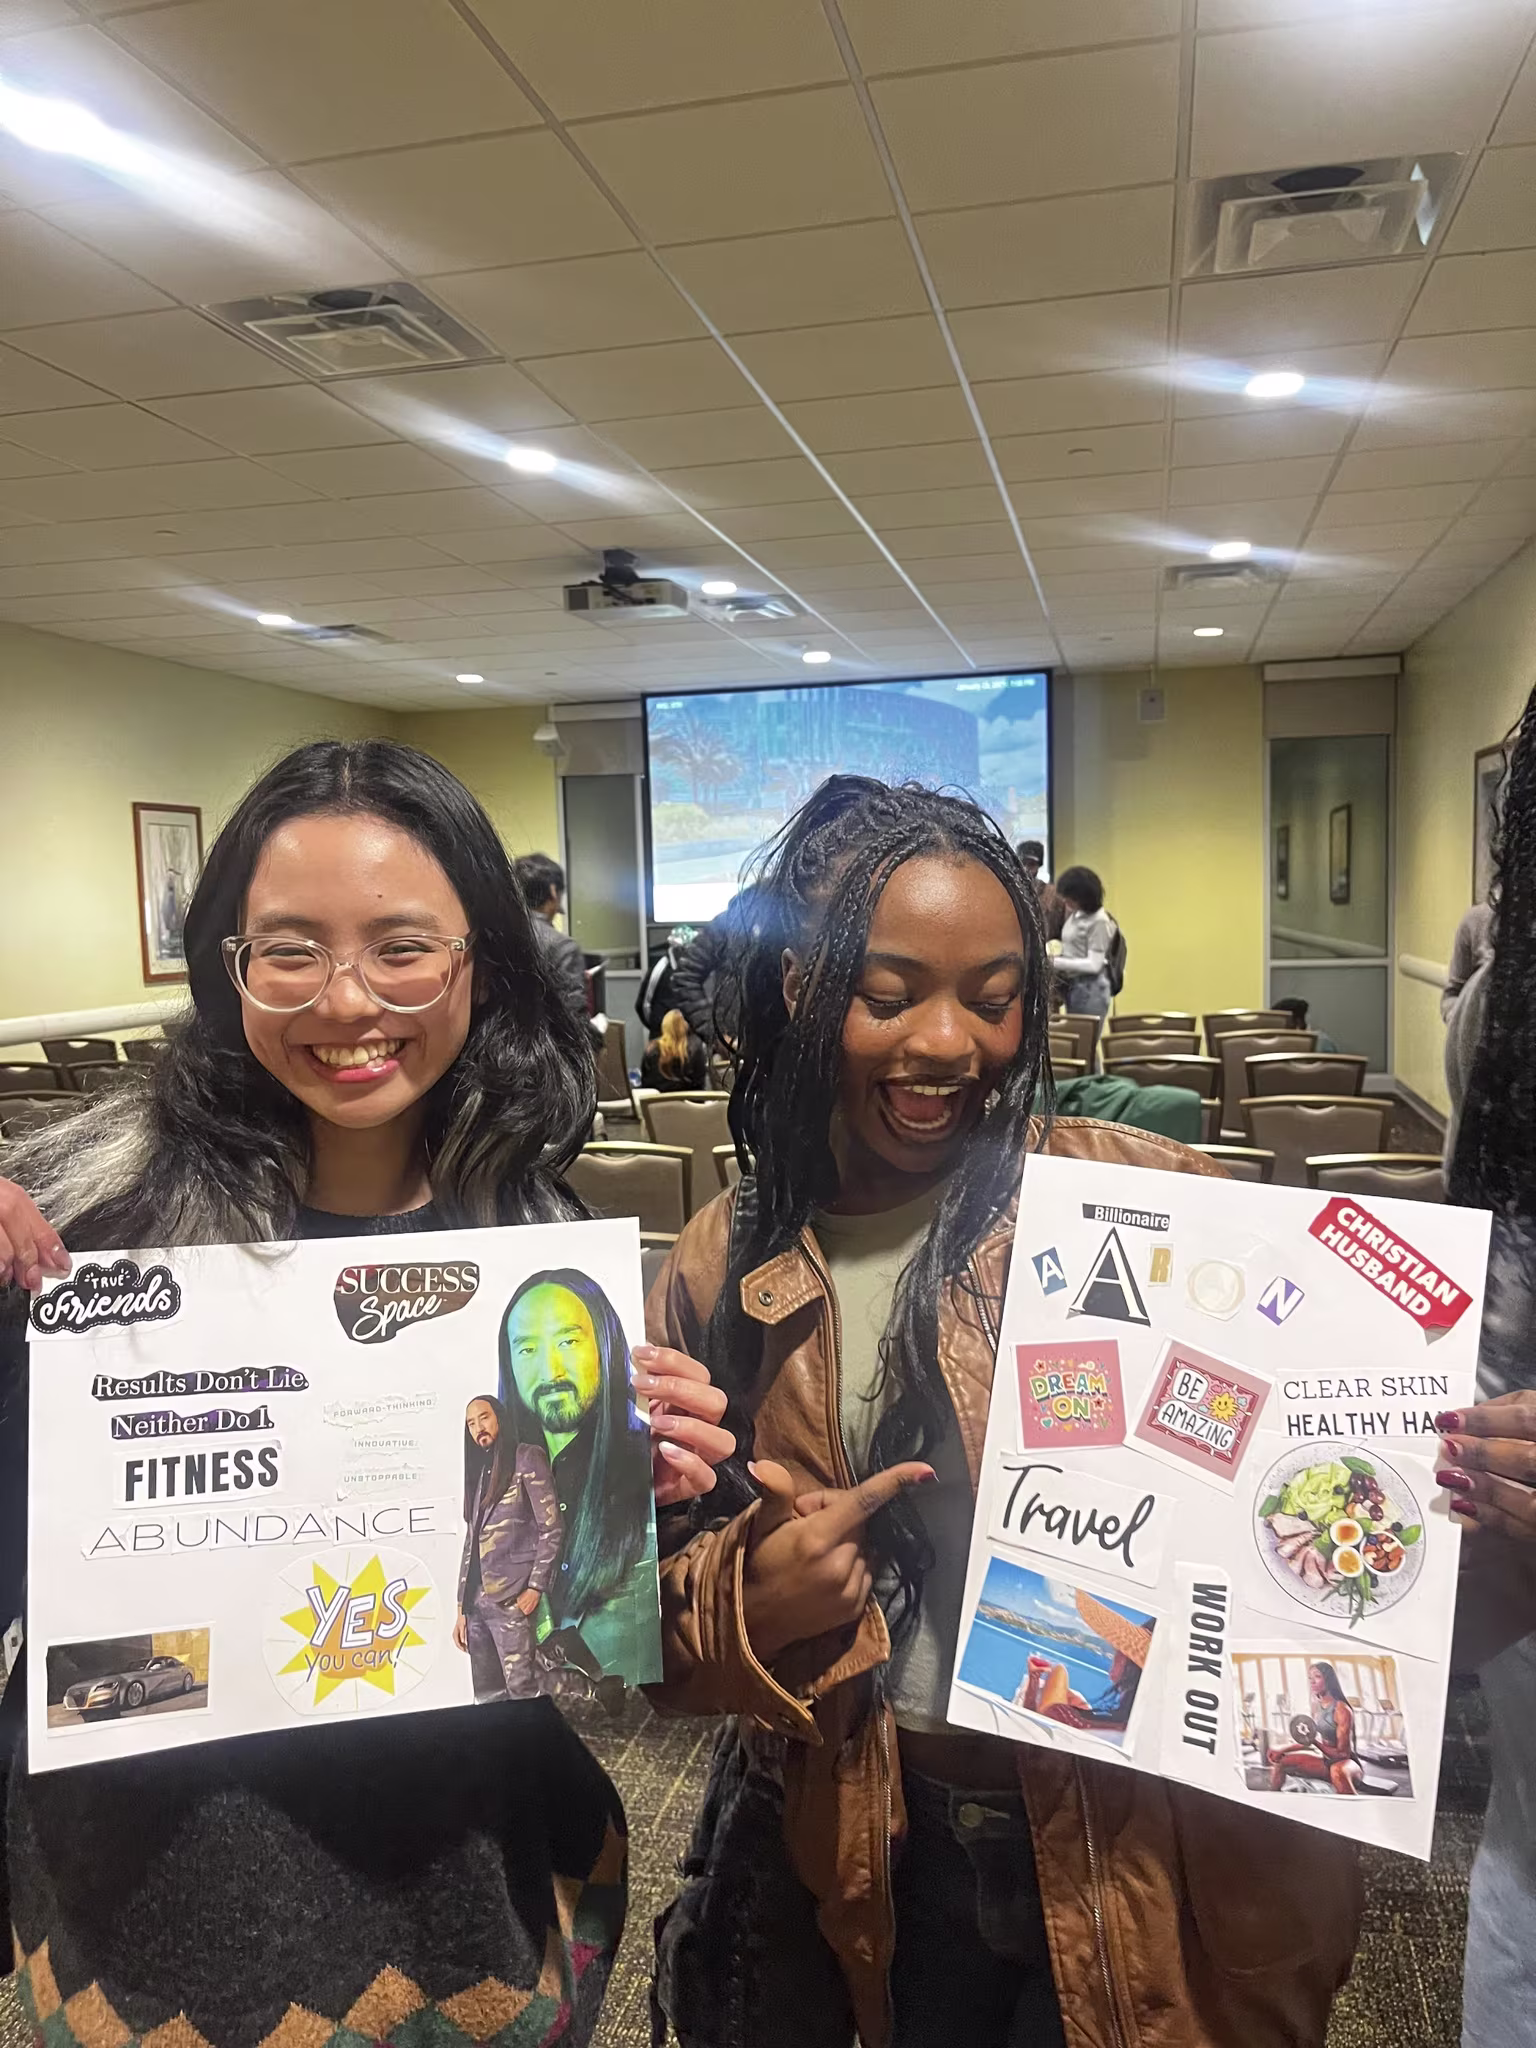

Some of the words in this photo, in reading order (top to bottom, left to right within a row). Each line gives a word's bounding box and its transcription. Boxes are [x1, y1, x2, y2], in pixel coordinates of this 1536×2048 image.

[1093, 1205, 1170, 1231] Billionaire
[1318, 1223, 1432, 1316] HUSBAND
[1336, 1206, 1461, 1307] CHRISTIAN
[91, 1274, 125, 1289] TRUE
[340, 1266, 478, 1295] SUCCESS
[39, 1274, 172, 1325] Friends
[351, 1294, 443, 1340] Space
[94, 1371, 187, 1398] Results
[193, 1368, 259, 1393] Don't
[266, 1368, 310, 1389] Lie.
[1029, 1371, 1109, 1403] DREAM
[1177, 1372, 1204, 1401] BE
[1283, 1378, 1373, 1400] CLEAR
[1381, 1375, 1449, 1397] SKIN
[113, 1410, 209, 1438] Neither
[215, 1409, 250, 1431] Do
[256, 1406, 274, 1429] I.
[1052, 1395, 1092, 1423] ON
[1287, 1411, 1390, 1437] HEALTHY
[125, 1447, 279, 1502] FITNESS
[343, 1472, 418, 1483] UNSTOPPABLE
[89, 1506, 436, 1556] ABUNDANCE
[1002, 1464, 1156, 1568] Travel
[305, 1578, 408, 1650] YES
[1187, 1582, 1228, 1679] WORK
[1182, 1688, 1220, 1756] OUT
